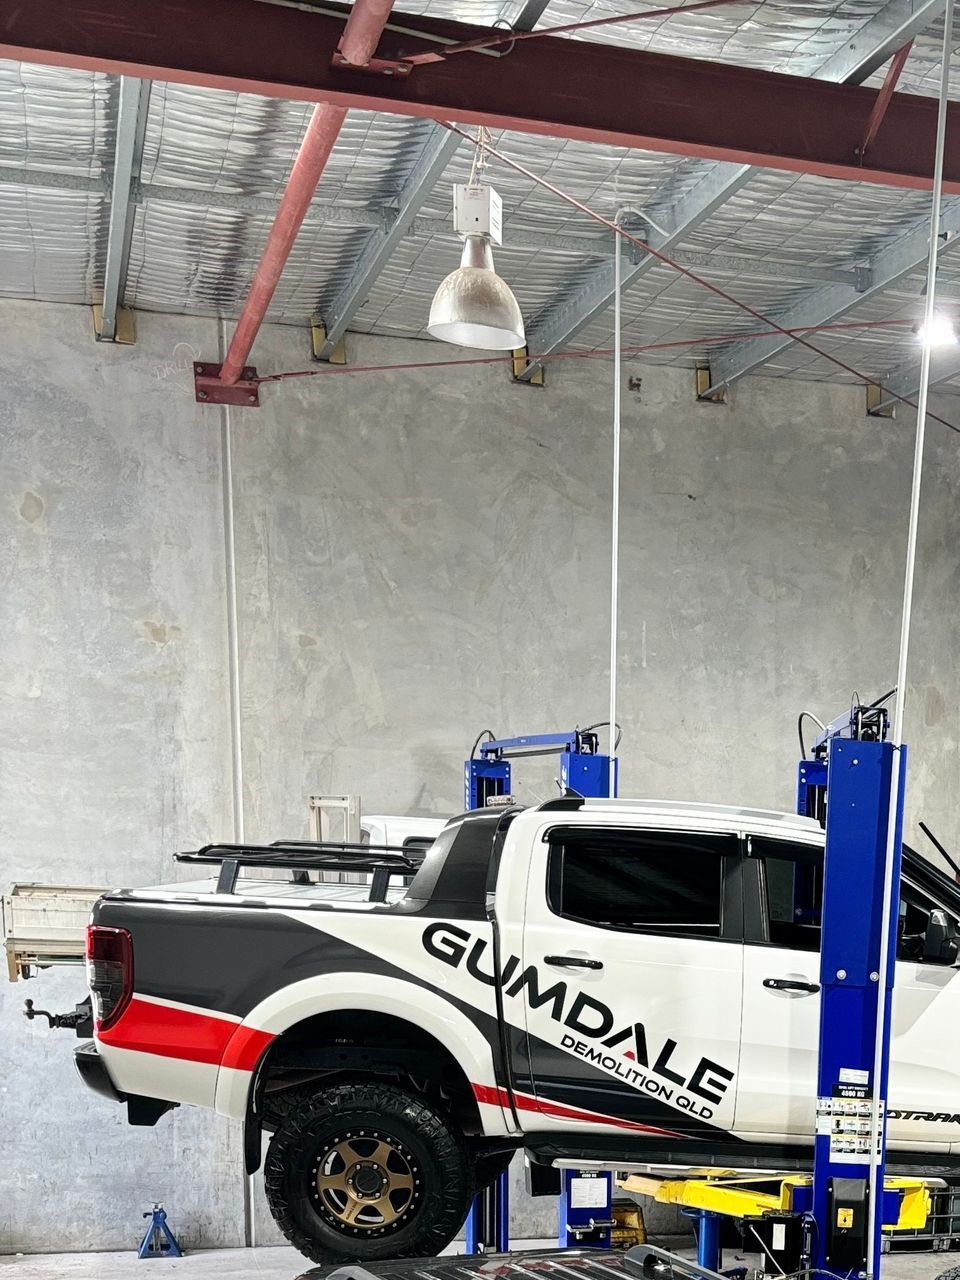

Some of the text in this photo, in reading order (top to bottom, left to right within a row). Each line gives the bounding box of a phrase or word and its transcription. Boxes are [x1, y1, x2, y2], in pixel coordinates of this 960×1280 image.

[422, 922, 734, 1105] GUMDALE
[560, 1034, 713, 1120] DEMOLITION QLD
